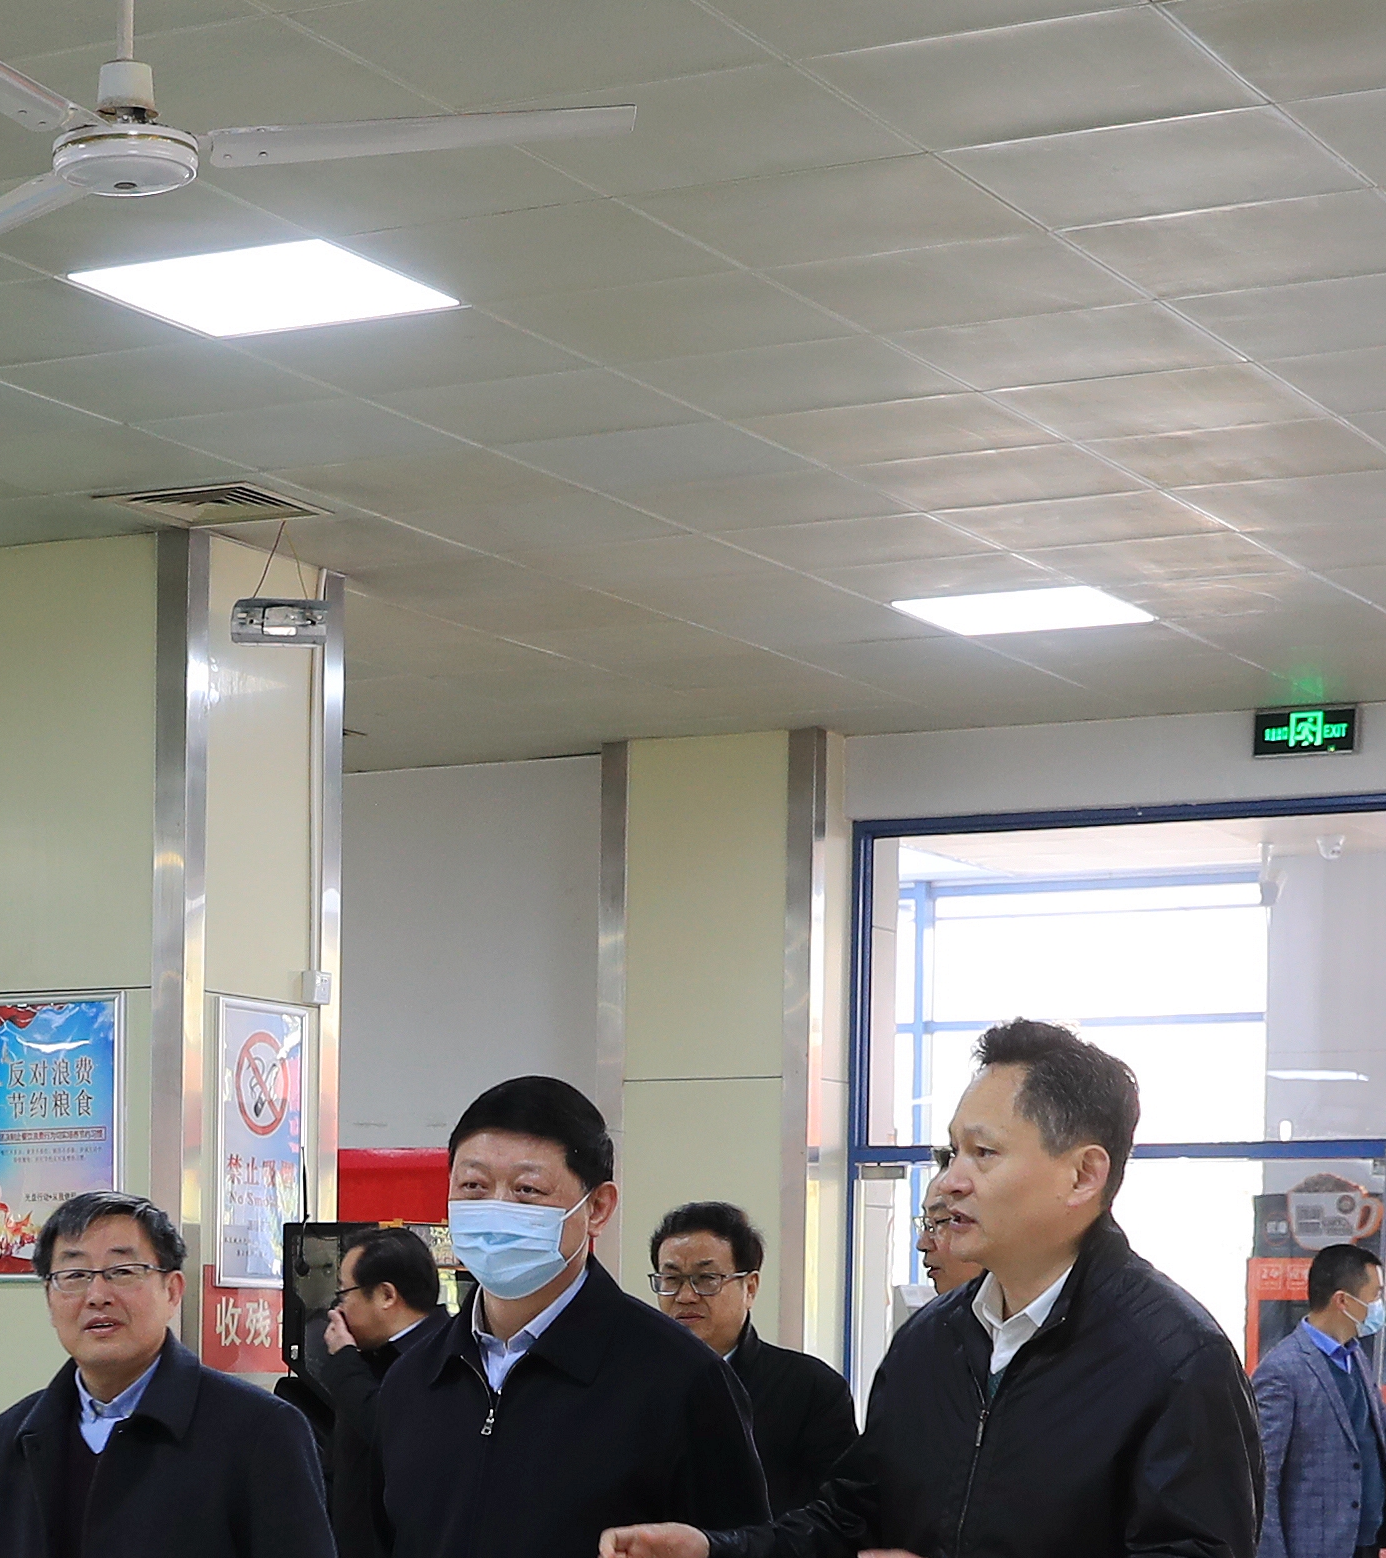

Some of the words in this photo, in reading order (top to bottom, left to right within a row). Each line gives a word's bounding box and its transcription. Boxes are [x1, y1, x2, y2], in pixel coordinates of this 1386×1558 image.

[1324, 723, 1348, 738] EXIT
[8, 1057, 94, 1088] 反对浪费
[8, 1089, 94, 1119] 节约粮食
[229, 1191, 245, 1205] No
[216, 1296, 284, 1348] 收残
